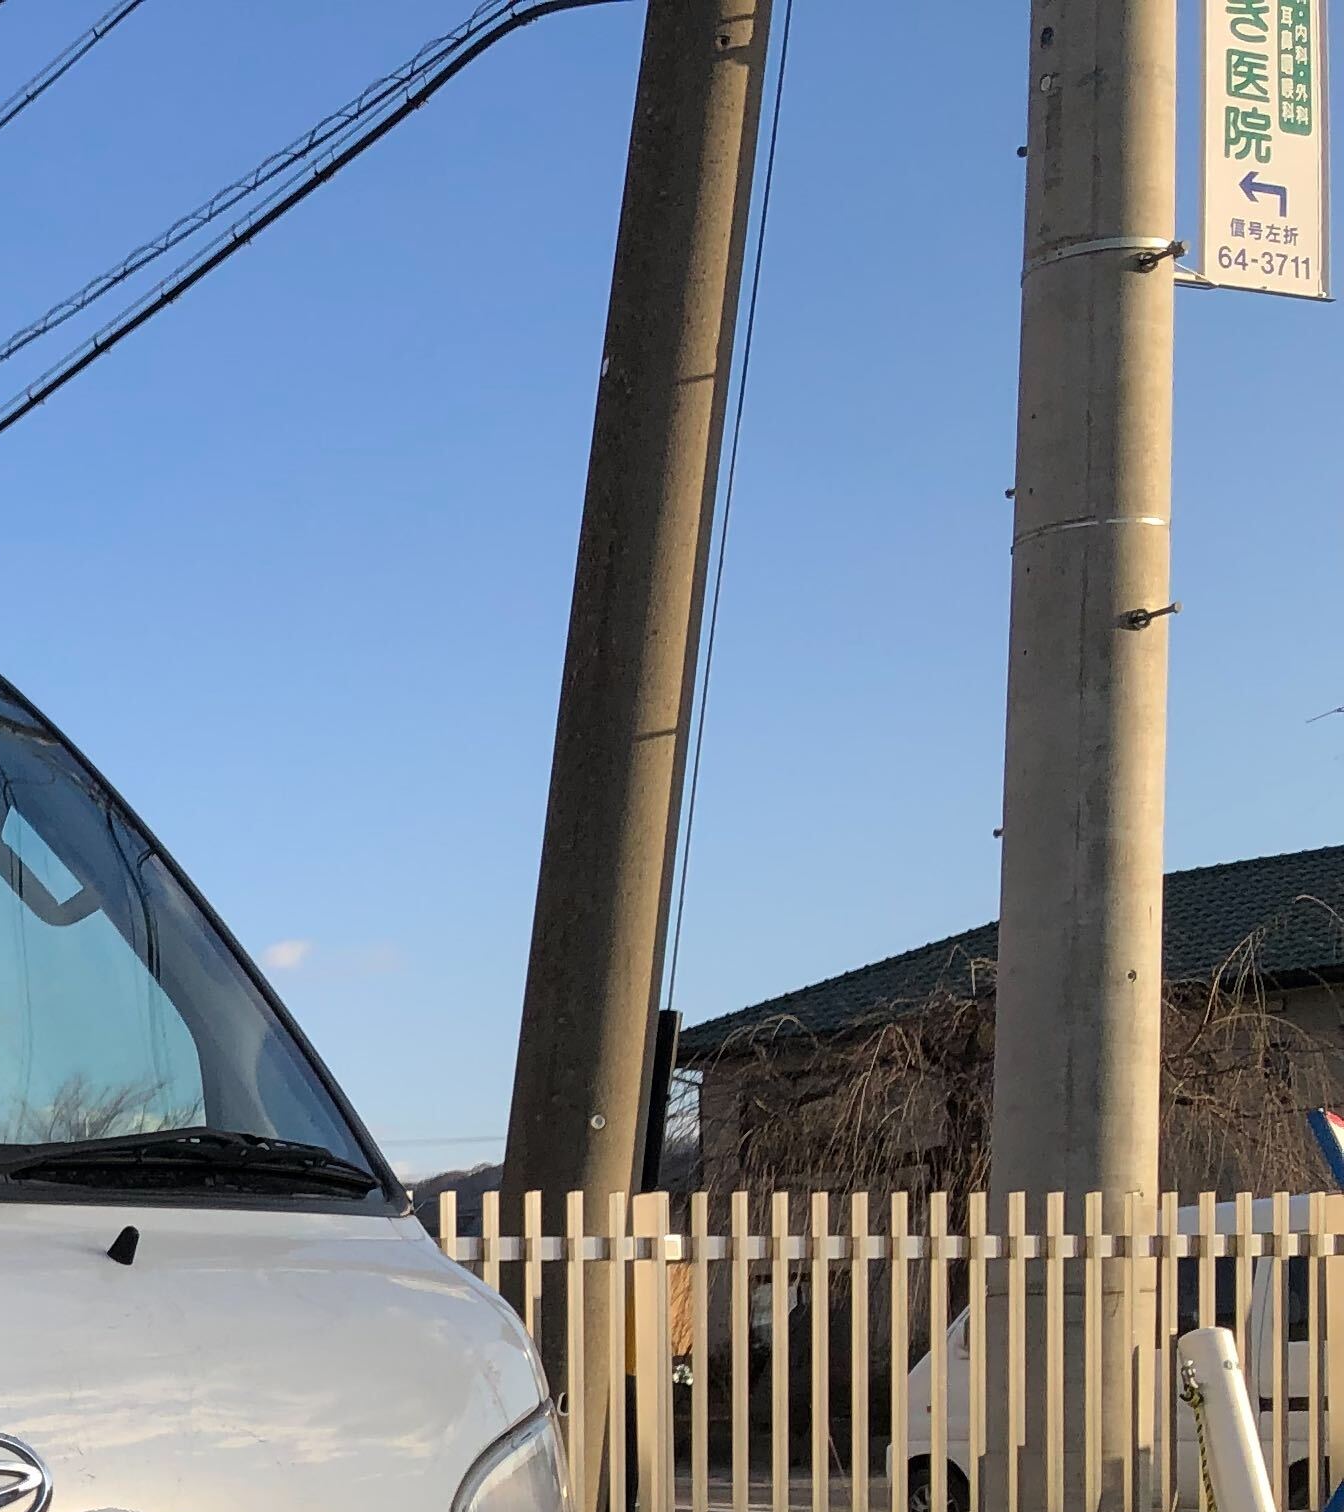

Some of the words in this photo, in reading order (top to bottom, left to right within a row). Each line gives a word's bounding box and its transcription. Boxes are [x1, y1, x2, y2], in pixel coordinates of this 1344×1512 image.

[1229, 217, 1299, 247] 信号左折
[1217, 245, 1311, 280] 64-3711
